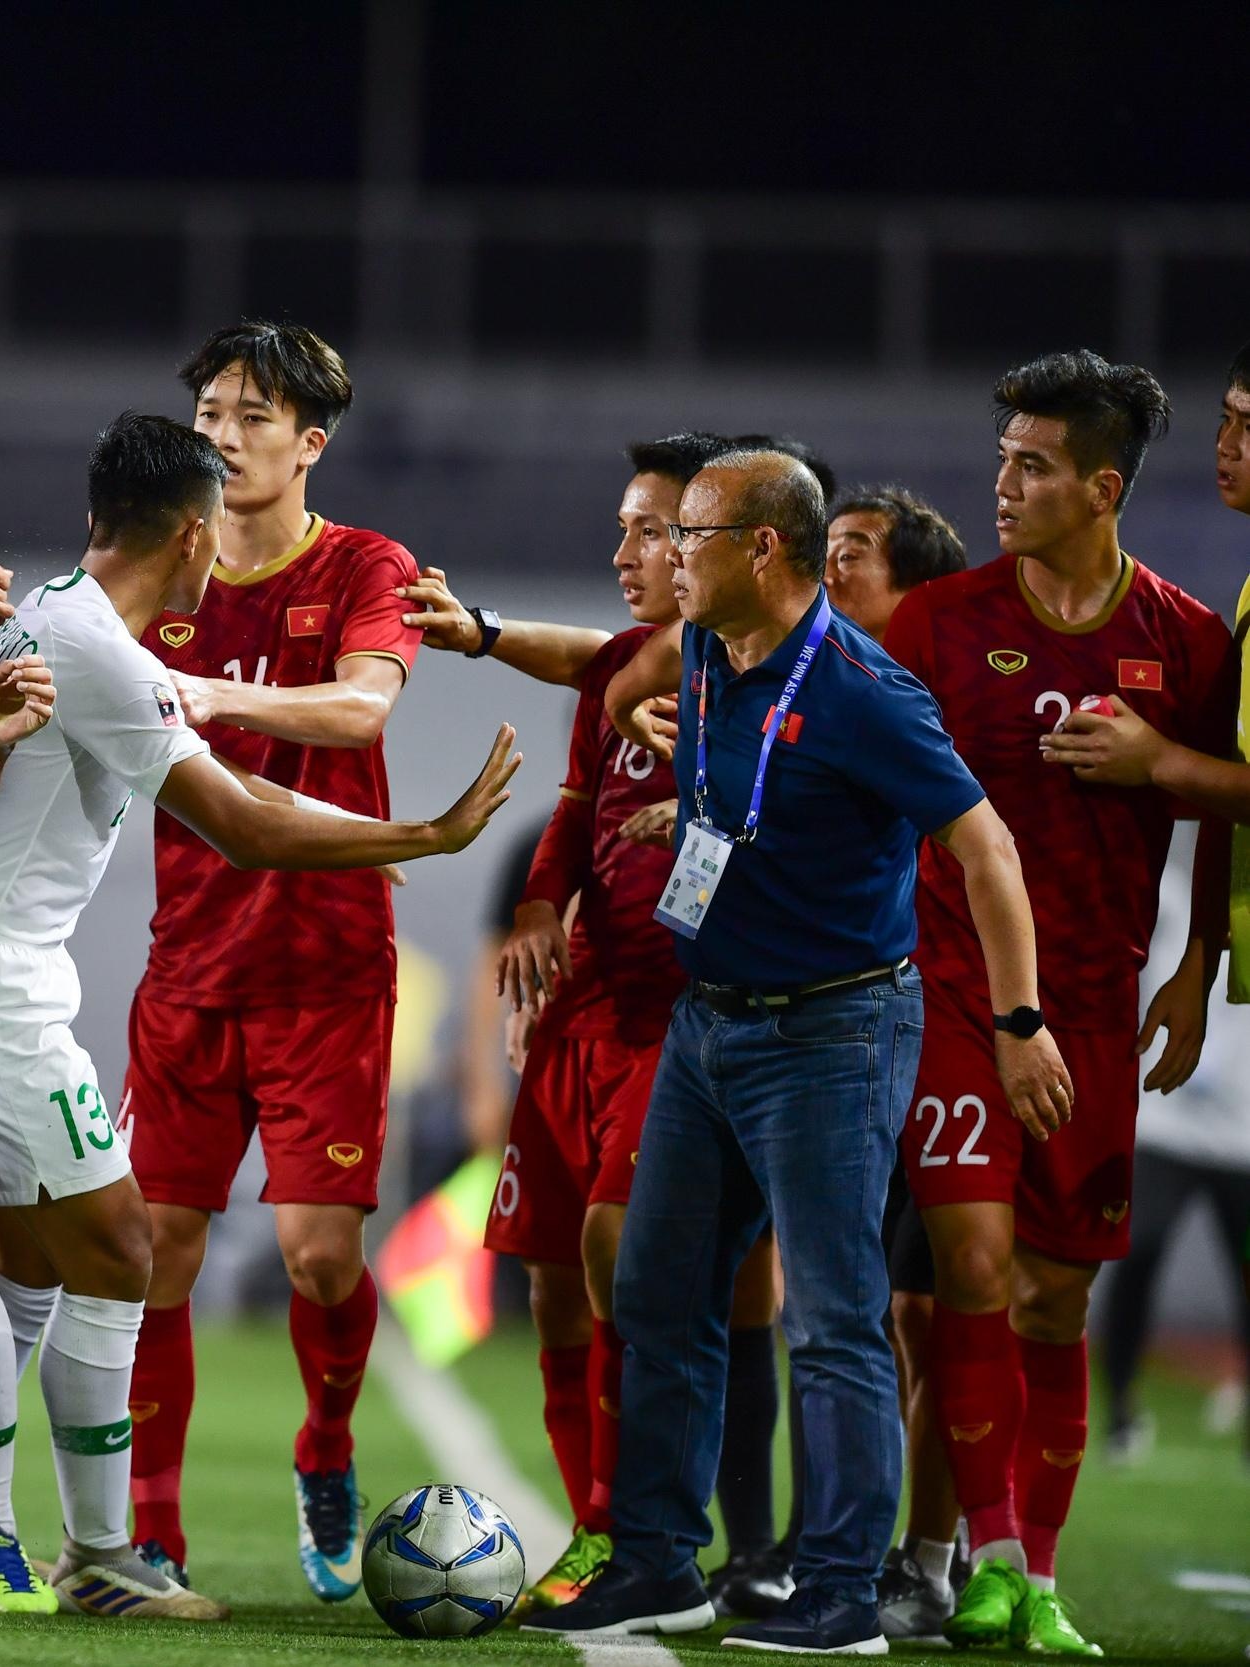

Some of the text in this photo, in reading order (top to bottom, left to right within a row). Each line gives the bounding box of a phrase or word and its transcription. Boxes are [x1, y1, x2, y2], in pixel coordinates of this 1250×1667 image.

[776, 645, 815, 714] WE WIN AS ONE
[49, 1082, 114, 1160] 13
[915, 1094, 990, 1168] 22
[493, 1144, 520, 1217] 6
